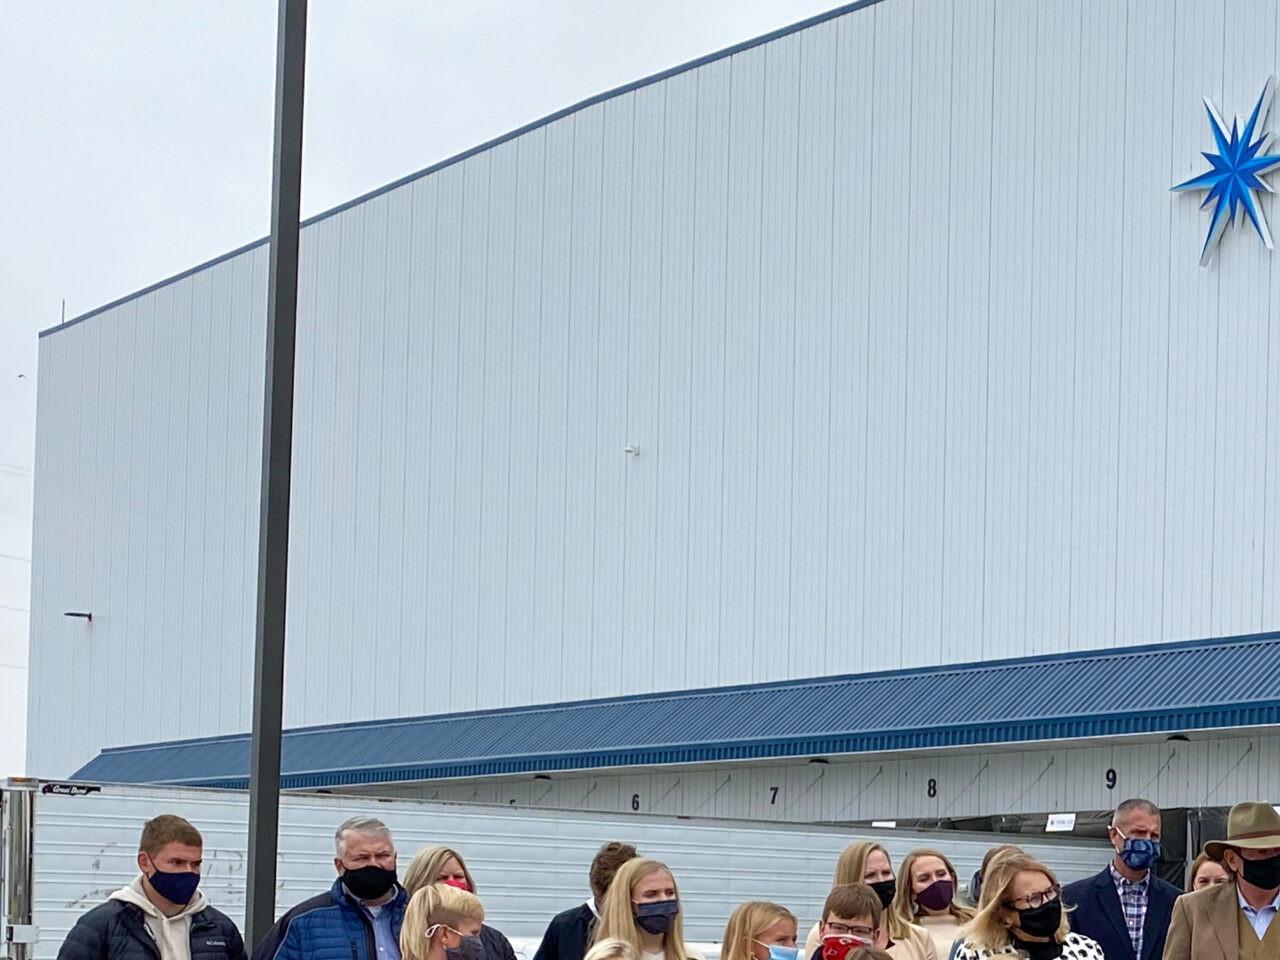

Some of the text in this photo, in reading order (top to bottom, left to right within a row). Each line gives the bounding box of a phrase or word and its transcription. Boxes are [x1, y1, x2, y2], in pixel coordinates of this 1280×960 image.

[926, 778, 938, 799] 8
[1105, 767, 1118, 790] 9
[631, 793, 641, 811] 6
[769, 786, 780, 805] 7
